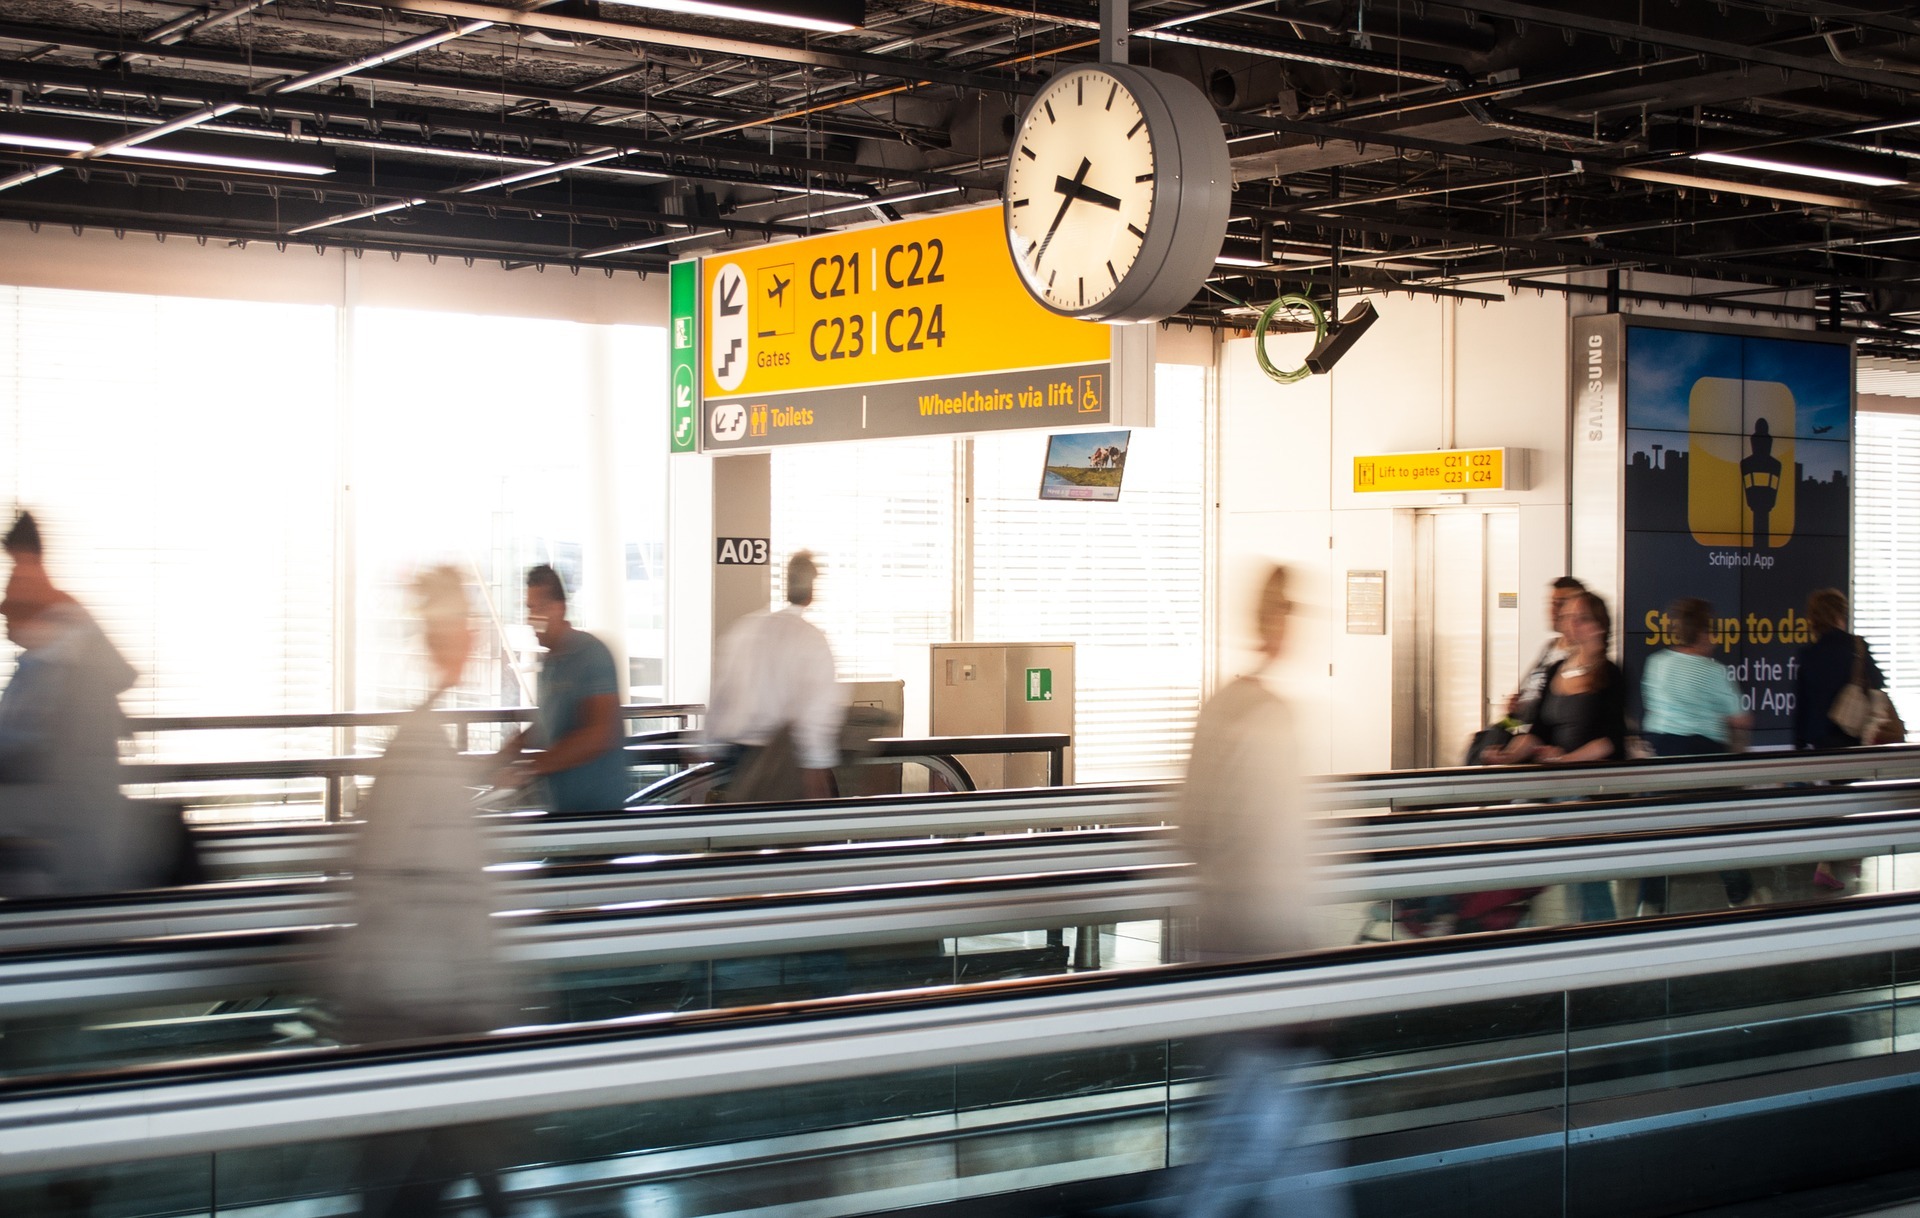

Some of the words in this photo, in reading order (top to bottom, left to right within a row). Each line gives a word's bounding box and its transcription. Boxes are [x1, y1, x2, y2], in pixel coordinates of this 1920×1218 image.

[809, 252, 859, 300] C21
[885, 238, 945, 289] C22
[809, 314, 864, 362] C23
[885, 303, 946, 353] C24
[757, 350, 791, 368] Gates
[918, 388, 1014, 416] Wheelchairs
[1018, 385, 1043, 409] via
[1048, 382, 1074, 406] lift
[1588, 334, 1603, 442] SAMSUNG
[770, 406, 814, 427] Toilets
[1379, 466, 1396, 478] Lift
[1399, 467, 1409, 478] to
[1412, 465, 1440, 480] gates
[1444, 456, 1463, 468] C21
[1472, 454, 1492, 466] C22
[1444, 471, 1463, 483] C23
[1472, 470, 1492, 482] C24
[718, 539, 768, 564] A03
[1708, 551, 1751, 569] Schiphol
[1753, 553, 1775, 570] App
[1645, 609, 1683, 646] Sta
[1708, 617, 1741, 653] up
[1746, 612, 1773, 644] to
[1753, 657, 1783, 682] the
[1760, 688, 1797, 716] App
